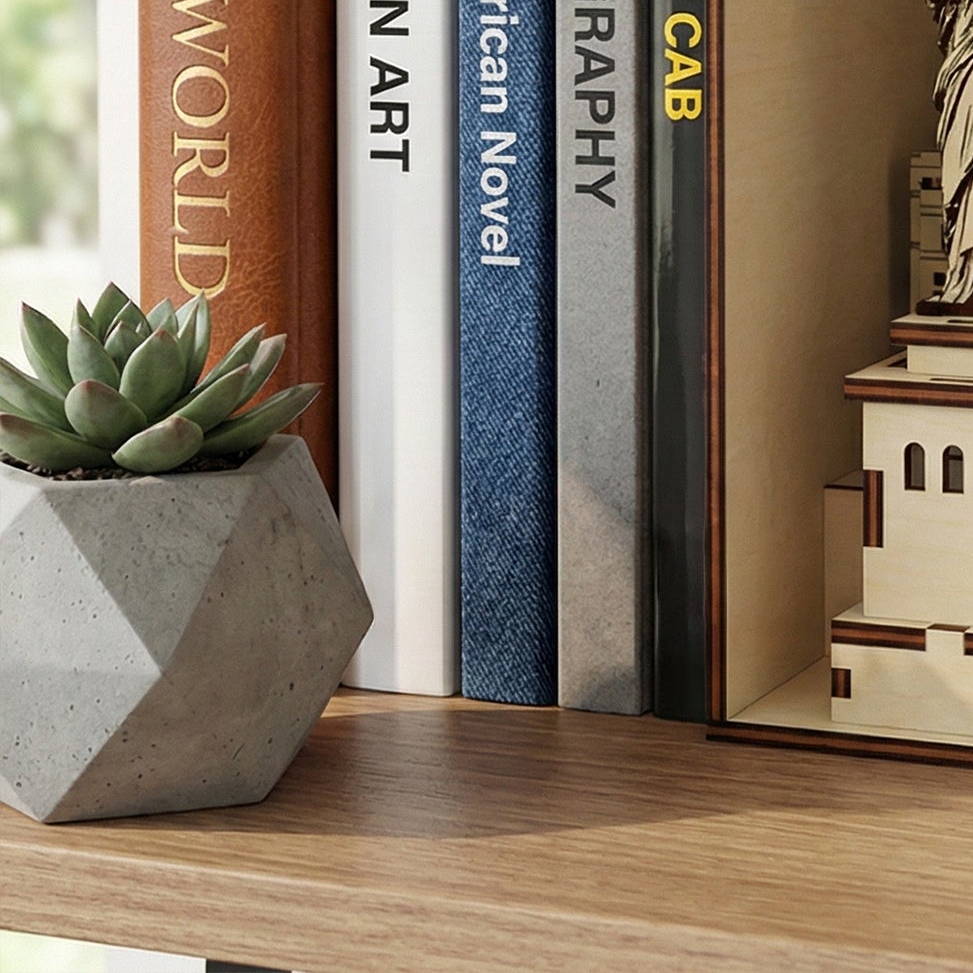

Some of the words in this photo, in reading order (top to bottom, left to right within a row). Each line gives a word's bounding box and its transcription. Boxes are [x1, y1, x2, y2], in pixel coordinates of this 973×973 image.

[368, 55, 411, 173] ART
[662, 12, 703, 123] CAB
[478, 130, 520, 270] Novel
